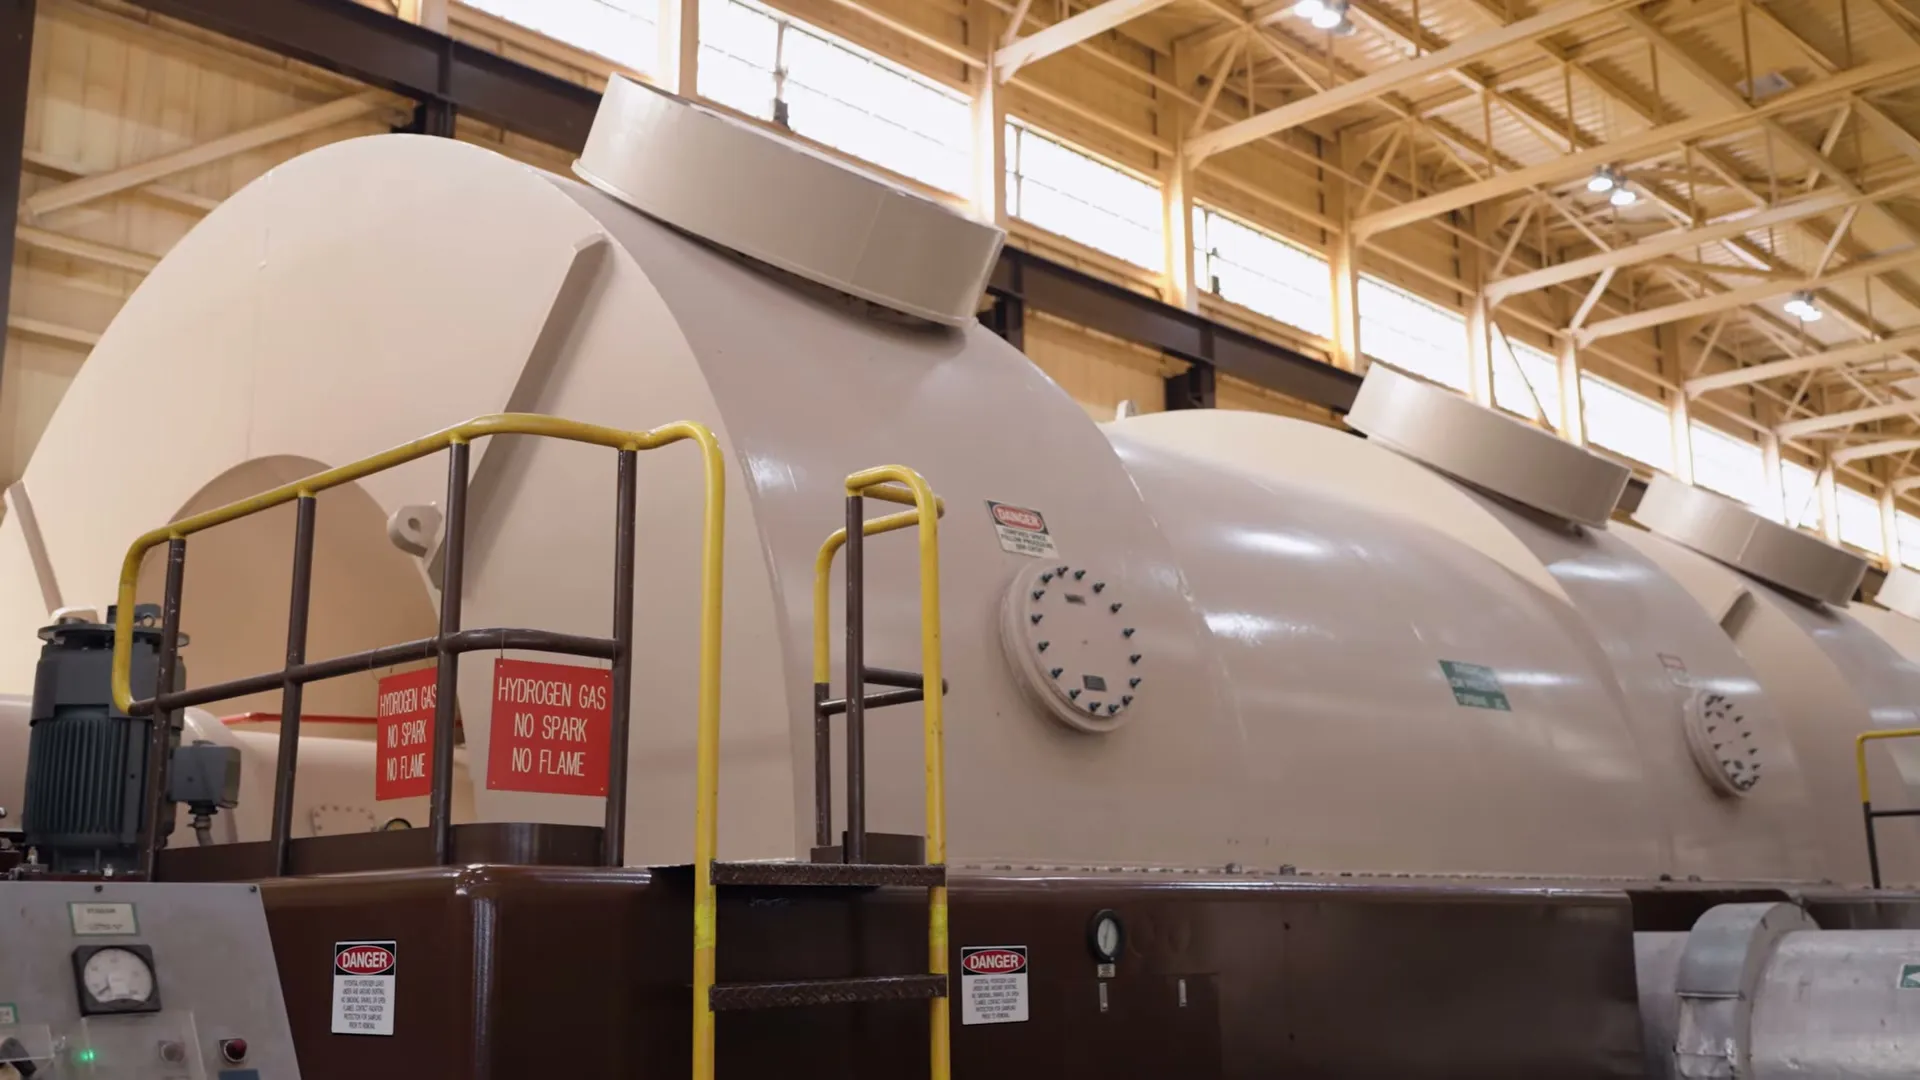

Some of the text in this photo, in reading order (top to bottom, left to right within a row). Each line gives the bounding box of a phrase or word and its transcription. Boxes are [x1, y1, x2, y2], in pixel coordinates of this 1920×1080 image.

[379, 683, 437, 718] HYDROGEN GAS
[498, 676, 607, 711] HYDROGEN GAS
[387, 719, 427, 749] NO SPARK
[514, 712, 588, 743] NO SPARK
[386, 753, 426, 782] NO FLAME
[512, 747, 586, 777] NO FLAME
[342, 951, 387, 968] DANGER
[970, 954, 1019, 970] DANGER
